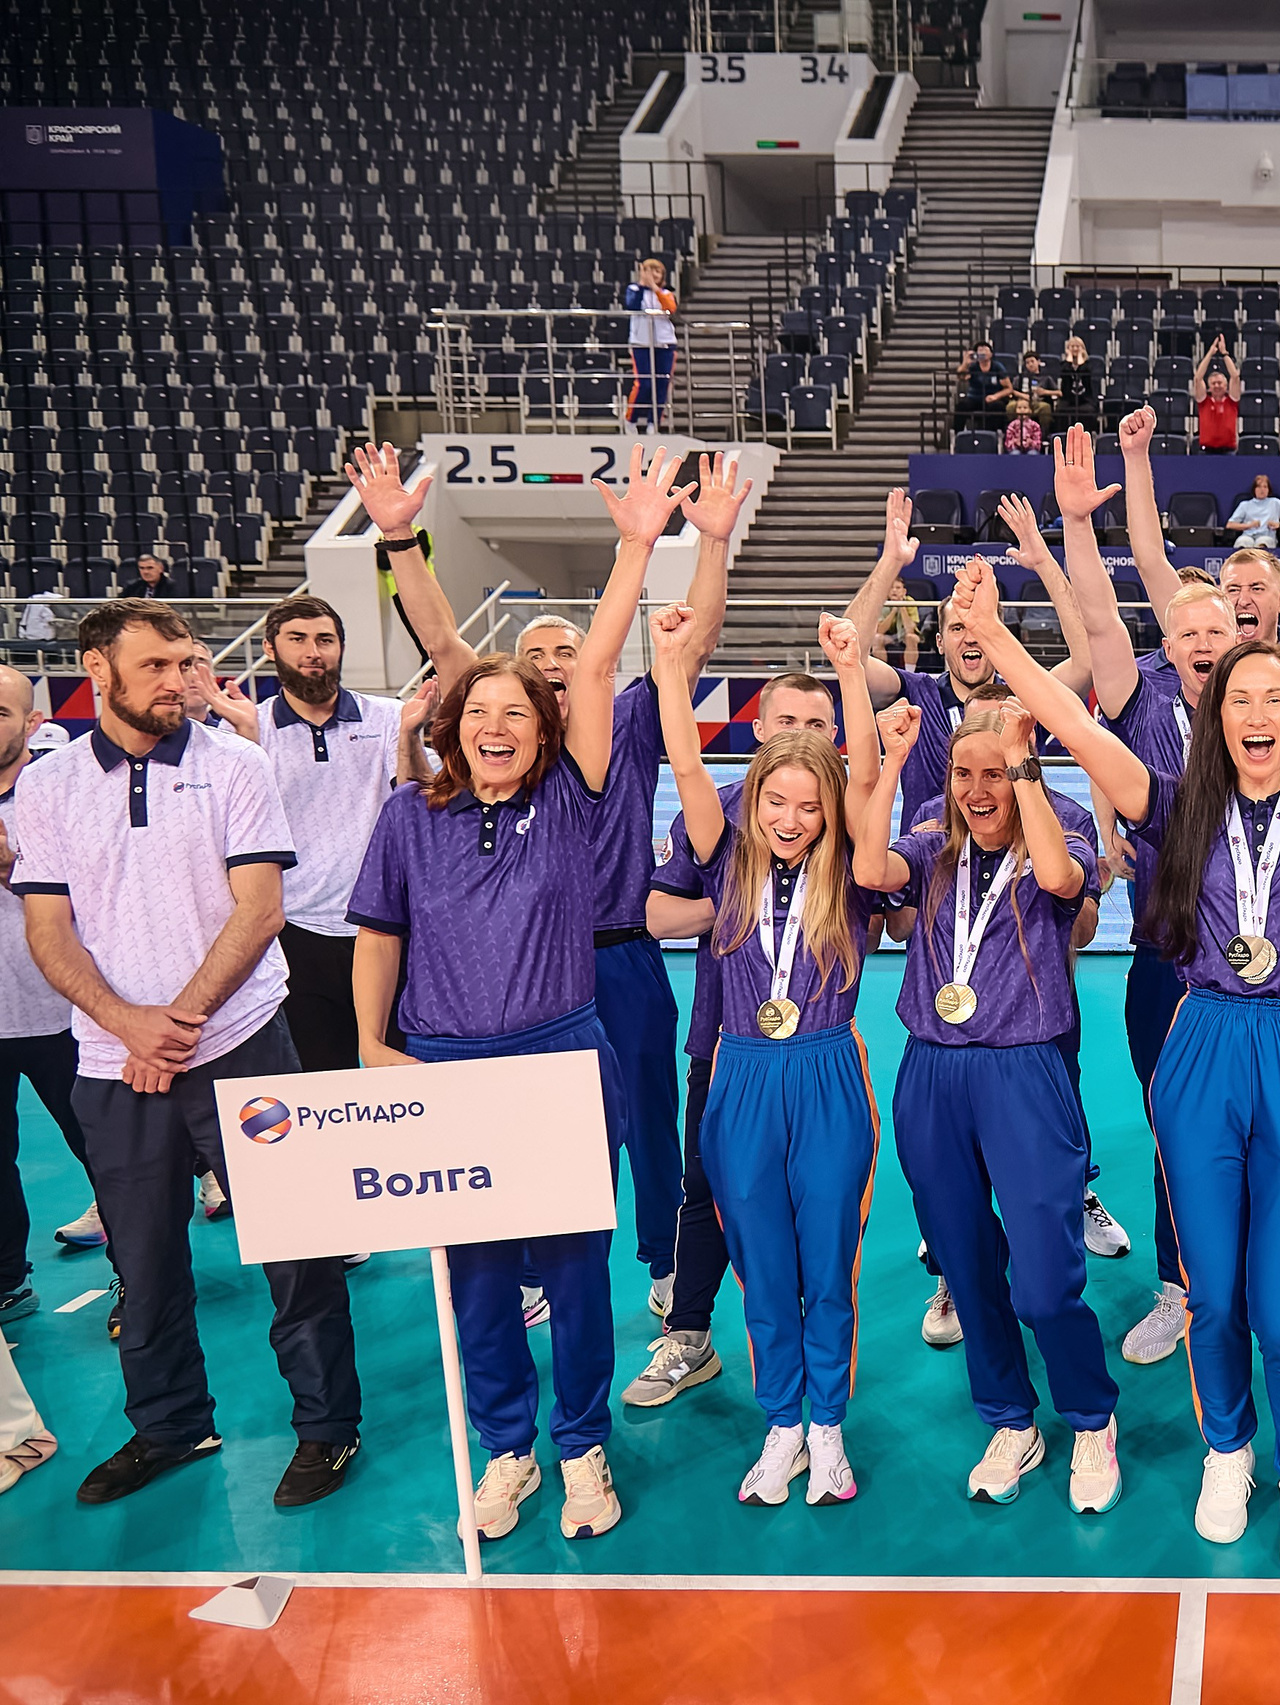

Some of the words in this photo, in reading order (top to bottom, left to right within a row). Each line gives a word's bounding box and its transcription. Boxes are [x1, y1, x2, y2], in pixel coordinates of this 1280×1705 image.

[700, 55, 746, 83] 3.5
[801, 55, 849, 84] 3.4
[48, 124, 122, 134] КРАСНОЯРСКИЙ
[48, 134, 74, 143] КРАЙ
[445, 445, 518, 483] 2.5
[591, 446, 641, 483] 2.
[297, 1101, 425, 1130] РусГидро
[352, 1165, 492, 1200] Волга
